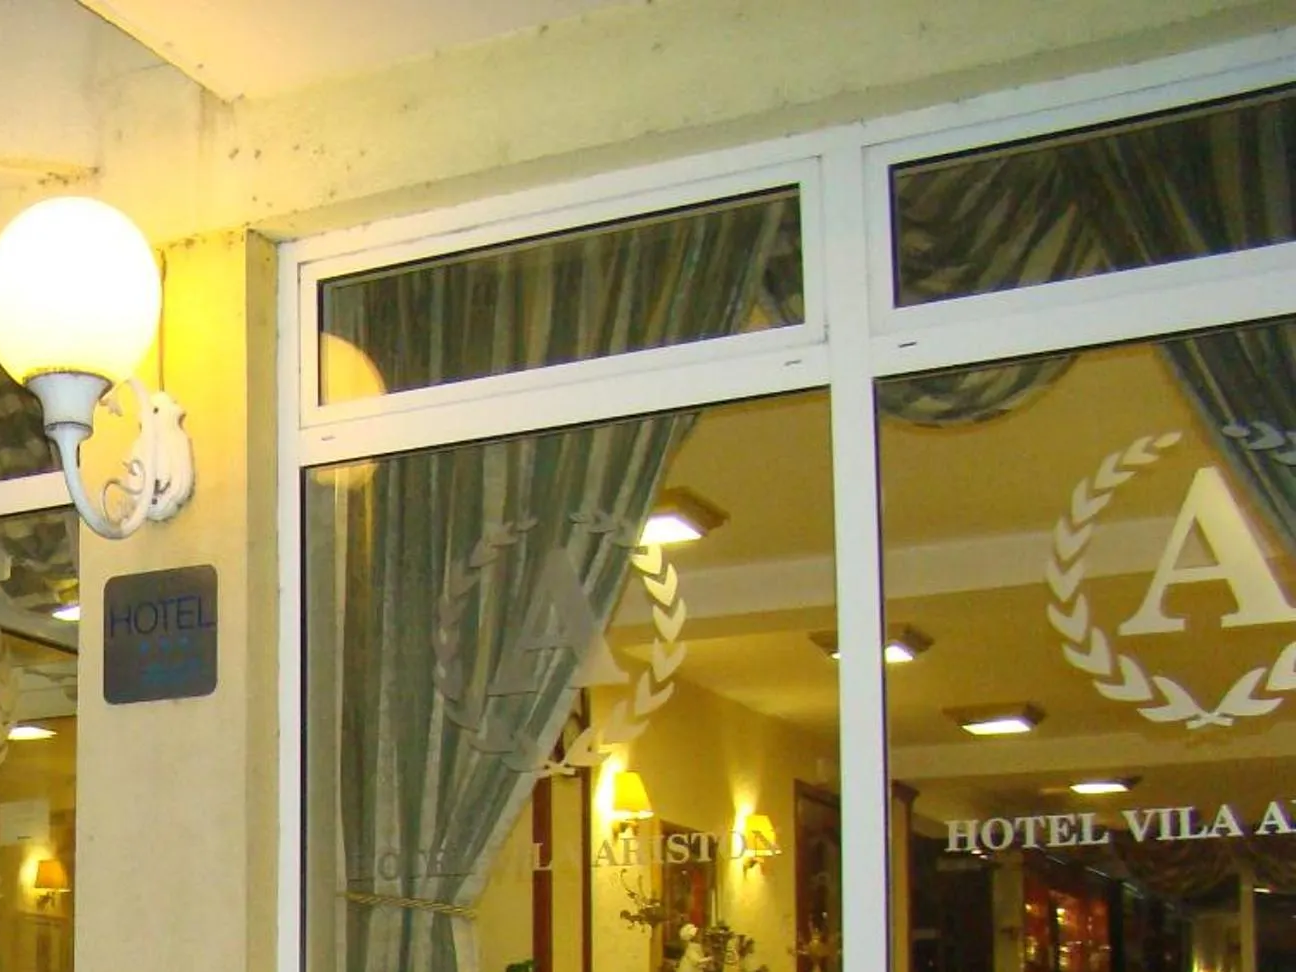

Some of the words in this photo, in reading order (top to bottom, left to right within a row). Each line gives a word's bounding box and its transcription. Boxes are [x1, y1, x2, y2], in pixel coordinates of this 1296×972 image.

[1118, 465, 1296, 636] A
[109, 595, 216, 638] HOTEL
[488, 547, 628, 696] A
[593, 830, 781, 868] ARISTON
[944, 813, 1109, 852] HOTEL
[1122, 804, 1244, 842] VILA
[1255, 800, 1296, 836] A
